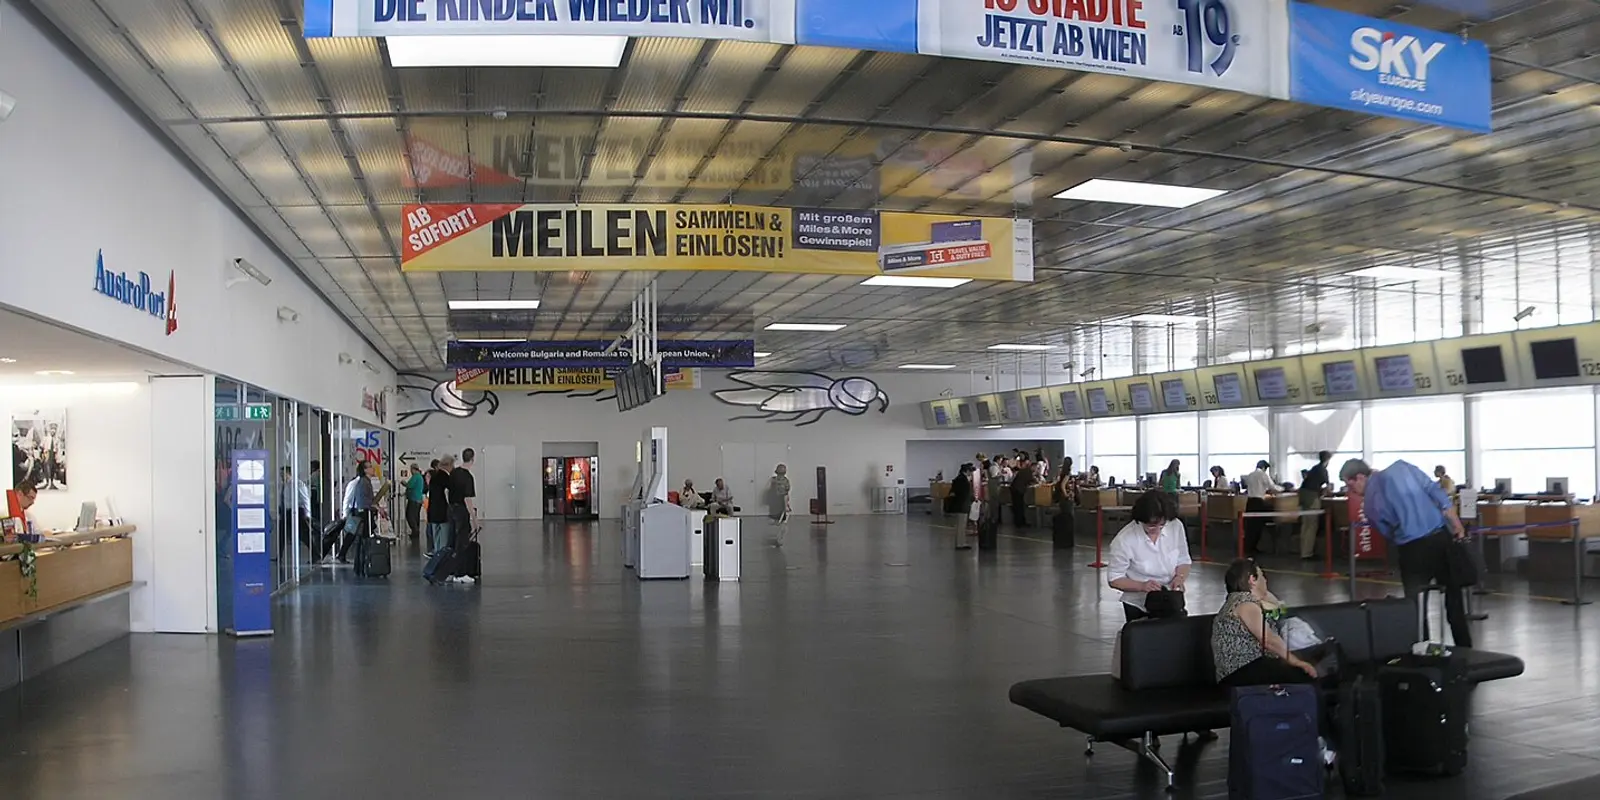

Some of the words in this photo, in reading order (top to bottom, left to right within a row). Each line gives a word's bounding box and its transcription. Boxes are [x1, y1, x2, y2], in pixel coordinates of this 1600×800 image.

[1172, 24, 1184, 36] AB
[976, 13, 1048, 52] JETZT
[1052, 22, 1084, 57] AB
[1088, 26, 1147, 66] WIEN
[1378, 73, 1426, 92] EUROPE
[1350, 88, 1443, 115] skyeurope.com
[407, 207, 432, 231] AB
[675, 210, 765, 230] SAMMELN
[769, 213, 783, 231] &
[800, 213, 820, 222] Mit
[823, 215, 872, 224] großem
[408, 206, 478, 252] SOFORT!
[491, 209, 667, 257] MEILEN
[676, 230, 784, 258] EINLÖSEN!
[800, 235, 872, 248] Gewinnspiel!
[93, 247, 166, 321] AustroPort
[492, 350, 529, 358] Welcome
[530, 350, 564, 360] Bulgaria
[565, 350, 581, 358] and
[582, 350, 618, 358] Romaia
[683, 350, 710, 358] Union.
[488, 368, 555, 385] MEILEN
[557, 374, 601, 385] EINLÖSEN!
[1415, 377, 1432, 389] 123
[1446, 374, 1464, 386] 124
[1205, 395, 1219, 405] 120
